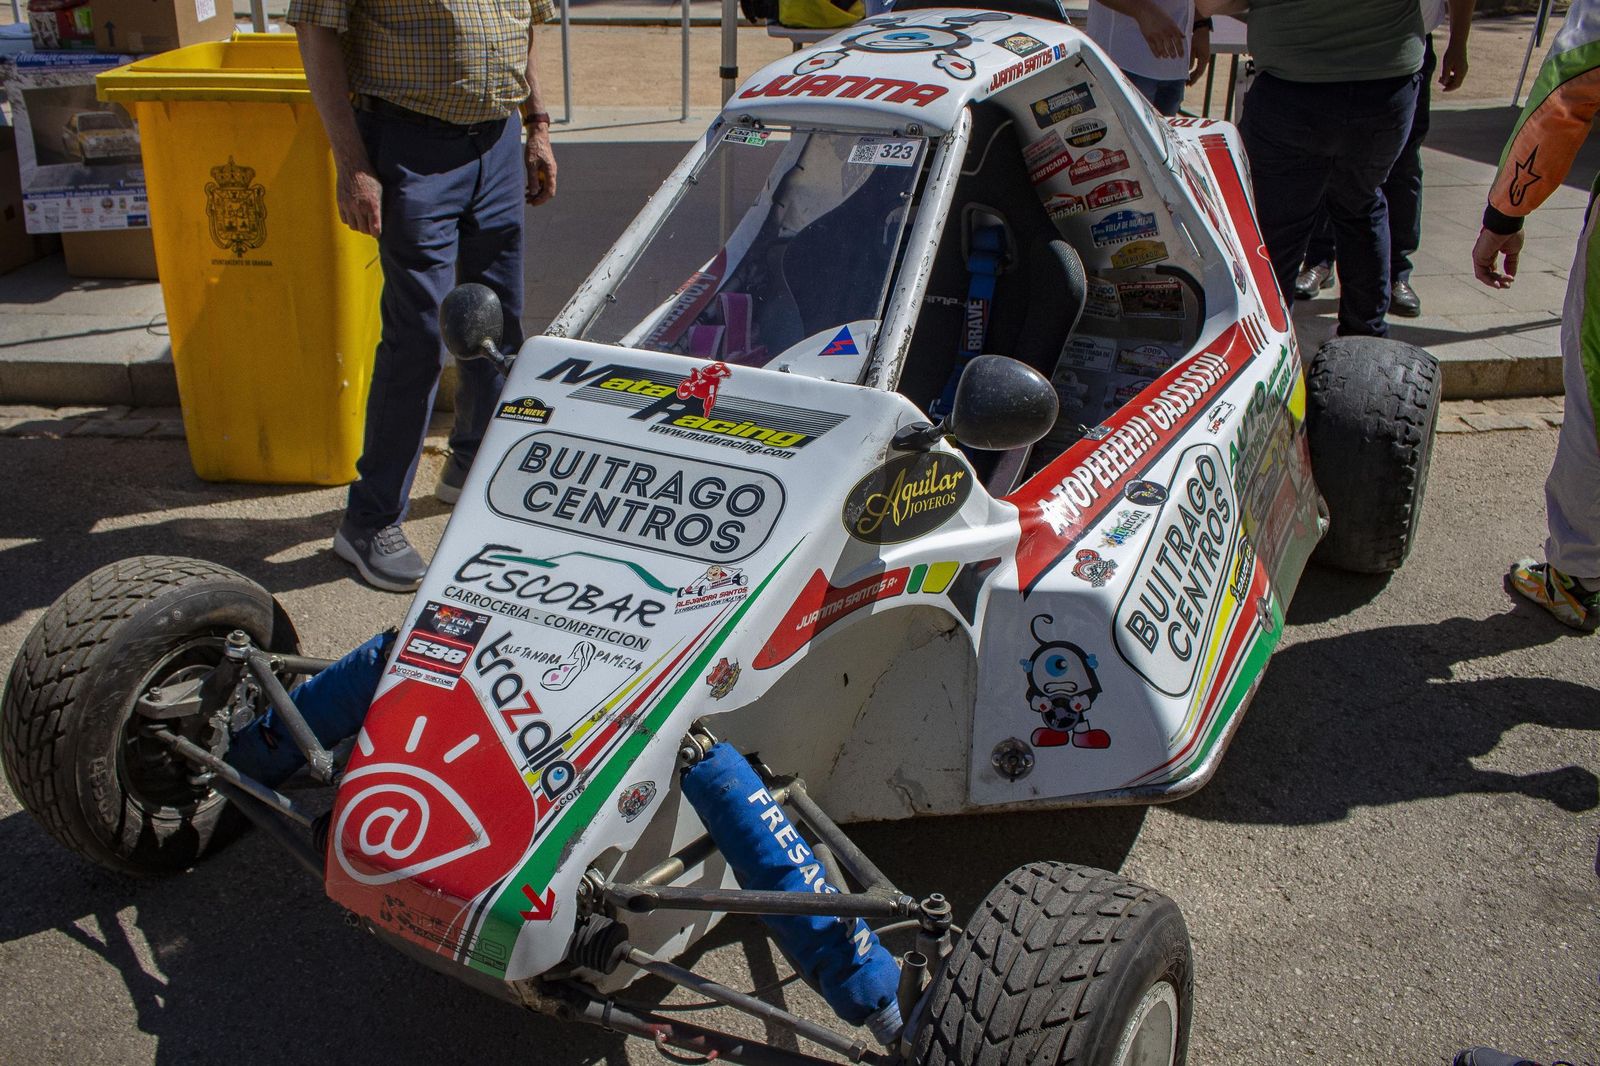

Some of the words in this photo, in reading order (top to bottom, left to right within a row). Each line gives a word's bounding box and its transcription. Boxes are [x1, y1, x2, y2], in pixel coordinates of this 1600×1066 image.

[739, 74, 950, 108] JUANMA
[990, 61, 1024, 92] JUANMA
[1023, 47, 1054, 77] SANTOS
[880, 144, 914, 160] 323
[967, 299, 984, 352] BRAVE
[501, 404, 517, 415] SOL
[525, 407, 547, 419] NIEVE
[648, 424, 797, 460] www.mataracing.com
[518, 440, 767, 518] BUITRAGO
[857, 461, 965, 535] Aguilar
[522, 480, 747, 554] CENTROS
[909, 491, 957, 518] JOYEROS
[1125, 454, 1216, 654] BUITRAGO
[1167, 487, 1231, 662] CENTROS
[454, 543, 667, 628] ESCOBAR
[675, 592, 718, 608] ALEJANDRA
[717, 586, 749, 599] SANTOS
[795, 599, 844, 631] JUANMA
[843, 582, 887, 609] SANTOS
[443, 585, 531, 621] CARROCERIA
[543, 613, 650, 651] COMPETICION
[406, 637, 468, 665] 538
[594, 650, 642, 671] PAMELA
[747, 787, 872, 957] FRESAGN
